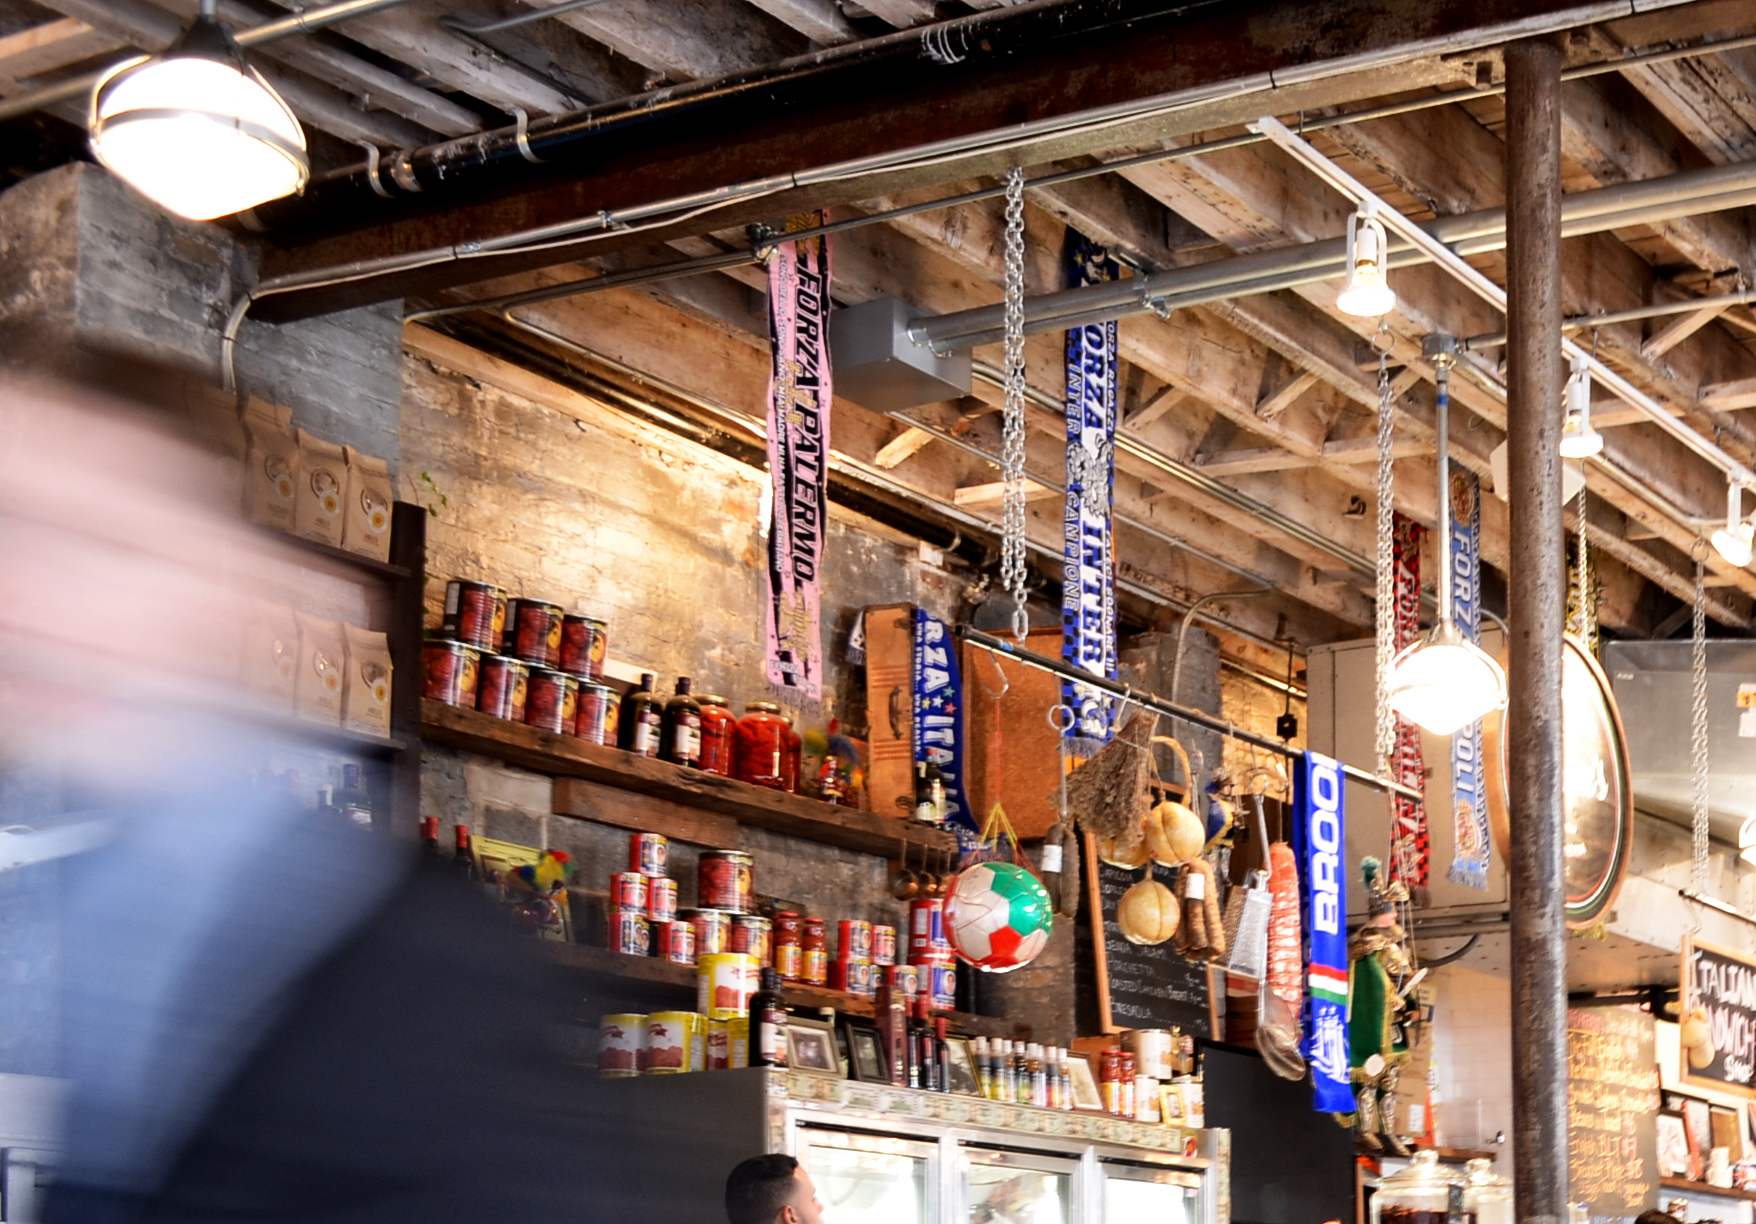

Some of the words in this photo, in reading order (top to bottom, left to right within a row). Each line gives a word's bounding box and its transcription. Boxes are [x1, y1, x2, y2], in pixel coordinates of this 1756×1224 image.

[794, 263, 822, 389] FORZA
[1082, 320, 1106, 430] ORZA
[1107, 320, 1116, 361] ORZA
[776, 409, 786, 442] MADRE
[1066, 363, 1082, 435] INTER
[1106, 369, 1115, 433] RAGAZZI
[792, 402, 820, 582] PALERMO
[1064, 491, 1080, 611] CAMPIONE
[1082, 521, 1105, 663] INTER
[1453, 530, 1472, 640] FORZ
[1105, 586, 1115, 653] SOGNARE
[1311, 753, 1339, 936] BROO
